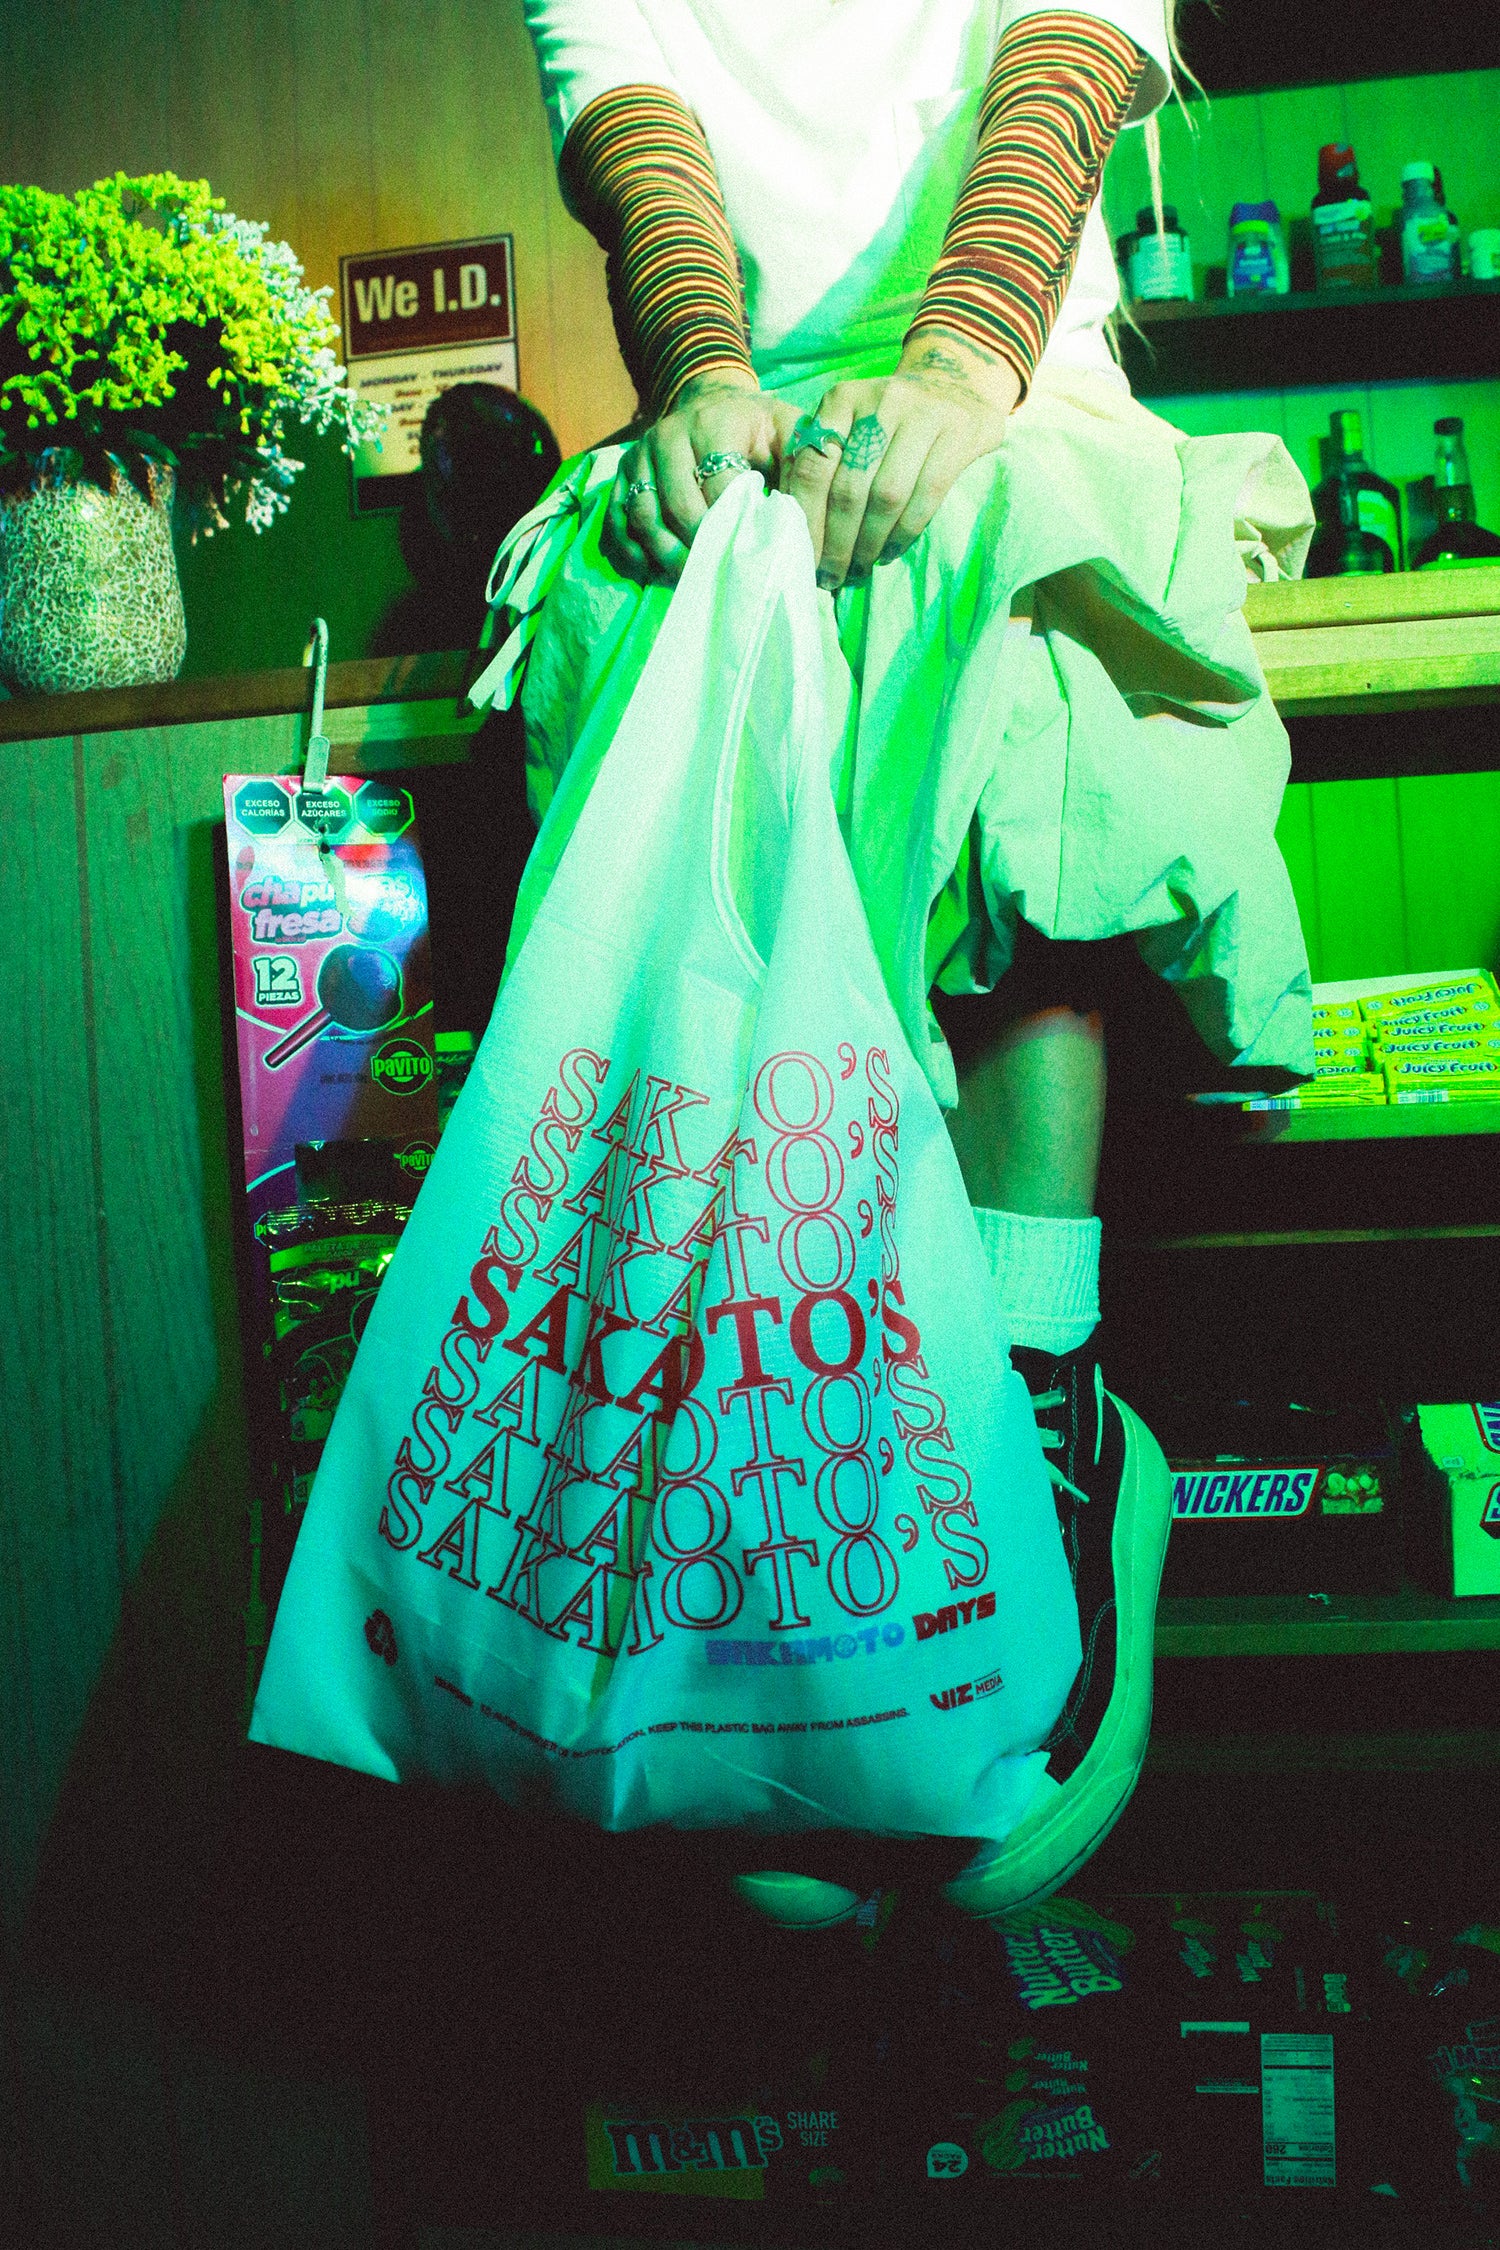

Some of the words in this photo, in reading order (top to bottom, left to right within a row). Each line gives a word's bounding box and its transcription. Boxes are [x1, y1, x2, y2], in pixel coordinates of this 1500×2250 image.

[354, 275, 419, 323] We
[433, 263, 501, 313] I.D.
[241, 808, 285, 817] CALORÍAS
[245, 800, 280, 808] EXCESO
[305, 801, 340, 809] EXCESO
[254, 909, 341, 939] fresa
[255, 959, 299, 991] 12
[258, 991, 300, 1002] PIEZAS
[1390, 1026, 1436, 1037] Juicy
[1438, 1021, 1482, 1033] Fruit
[1383, 1043, 1430, 1054] Juicy
[1432, 1039, 1477, 1052] Fruit
[1398, 1061, 1446, 1074] Juicy
[1449, 1061, 1494, 1073] Fruit
[1172, 1473, 1310, 1515] NICKERS
[912, 1592, 997, 1641] DAYS
[929, 1682, 975, 1711] VIZ
[975, 1674, 1003, 1695] MEDIA
[648, 1721, 678, 1734] KEEP
[679, 1721, 702, 1733] THIS
[705, 1722, 750, 1734] PLASTIC
[752, 1722, 775, 1734] BAG
[810, 1719, 844, 1732] FROM
[786, 2110, 840, 2131] SHARE
[1018, 2103, 1096, 2143] Butter
[799, 2131, 830, 2147] SIZE
[1029, 2123, 1111, 2160] Nutter
